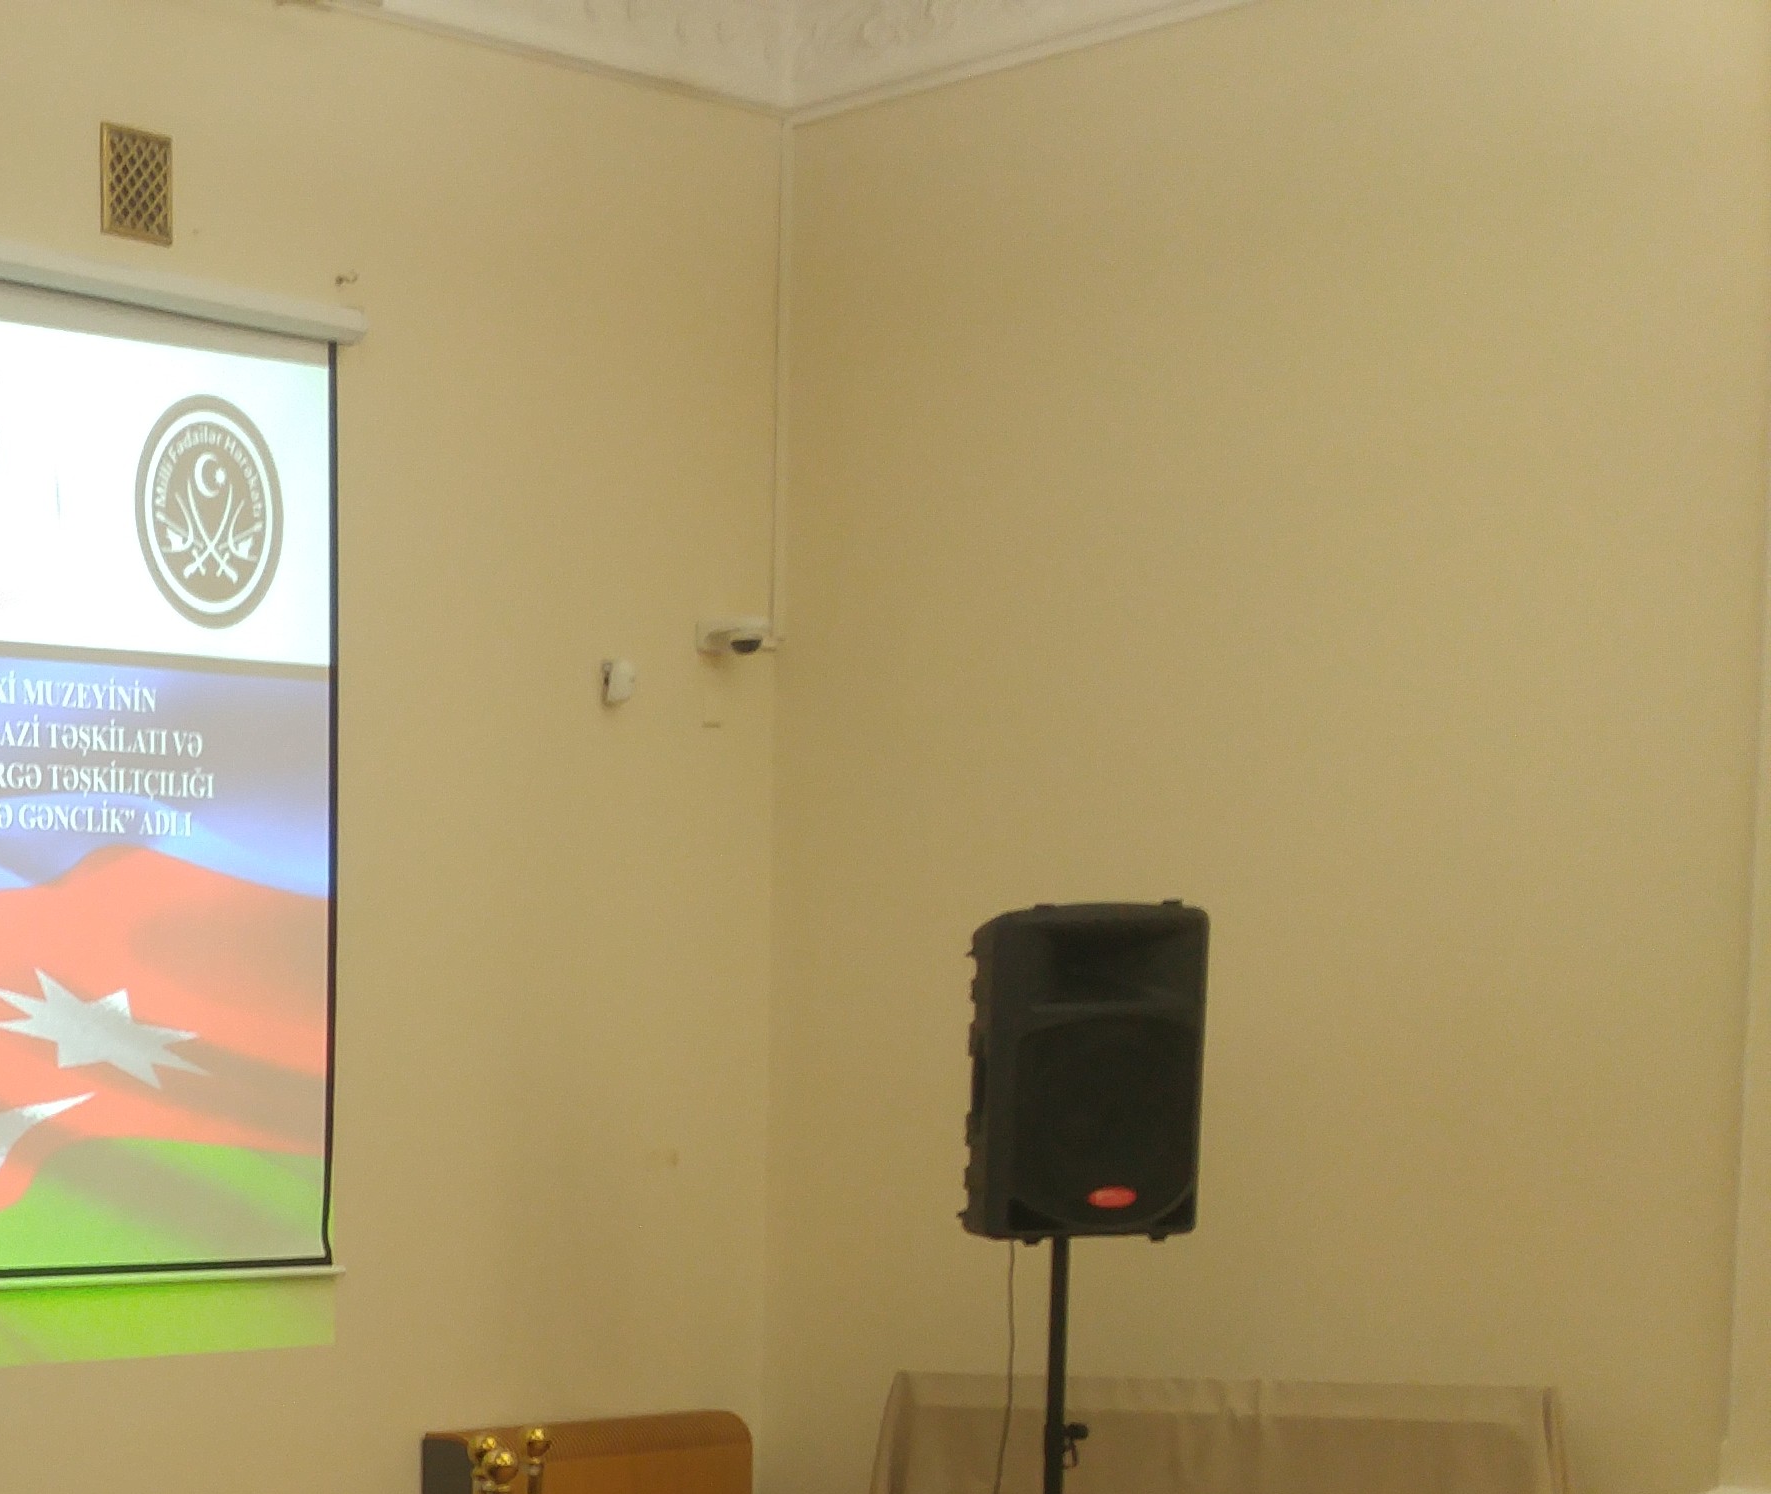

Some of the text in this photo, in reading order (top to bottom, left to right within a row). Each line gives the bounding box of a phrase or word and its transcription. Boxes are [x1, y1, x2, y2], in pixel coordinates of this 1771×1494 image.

[23, 678, 156, 712] MUZEYİNİN
[51, 719, 167, 756] TƏŞKİLATI
[173, 731, 202, 757] VƏ
[20, 803, 136, 833] GƏNCLİK”
[139, 810, 191, 837] ADLI
